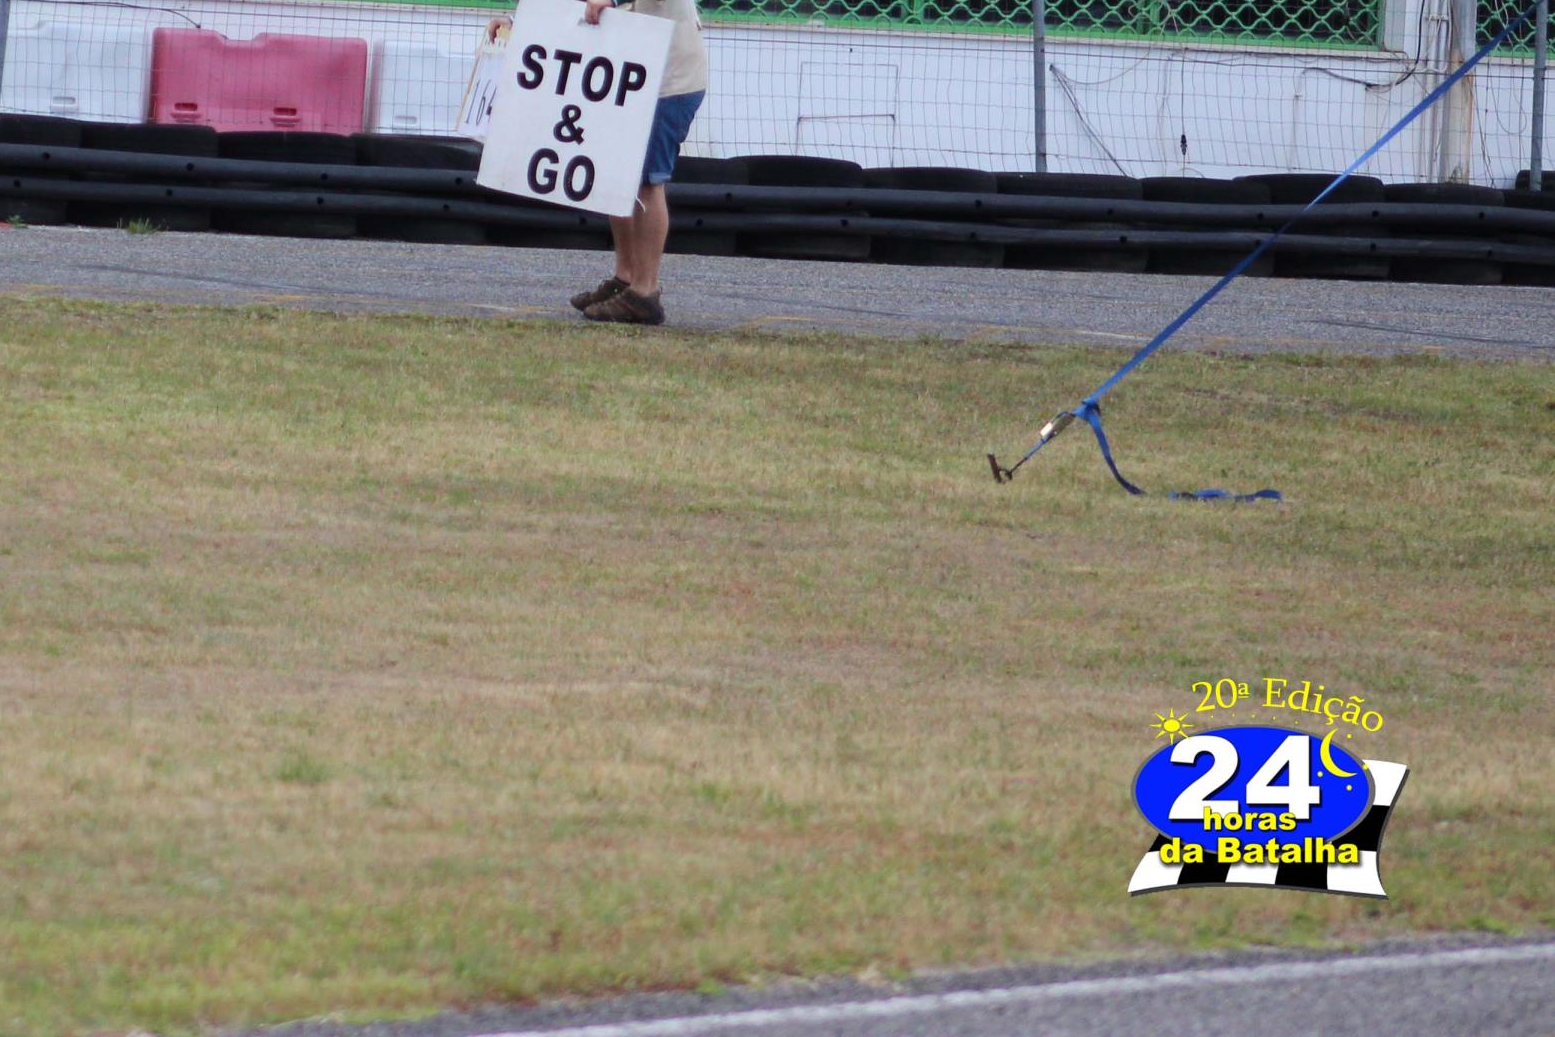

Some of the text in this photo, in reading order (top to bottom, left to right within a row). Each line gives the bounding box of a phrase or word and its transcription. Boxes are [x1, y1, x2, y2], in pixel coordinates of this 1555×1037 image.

[516, 44, 647, 107] STOP
[553, 104, 585, 145] &
[527, 147, 596, 202] GO
